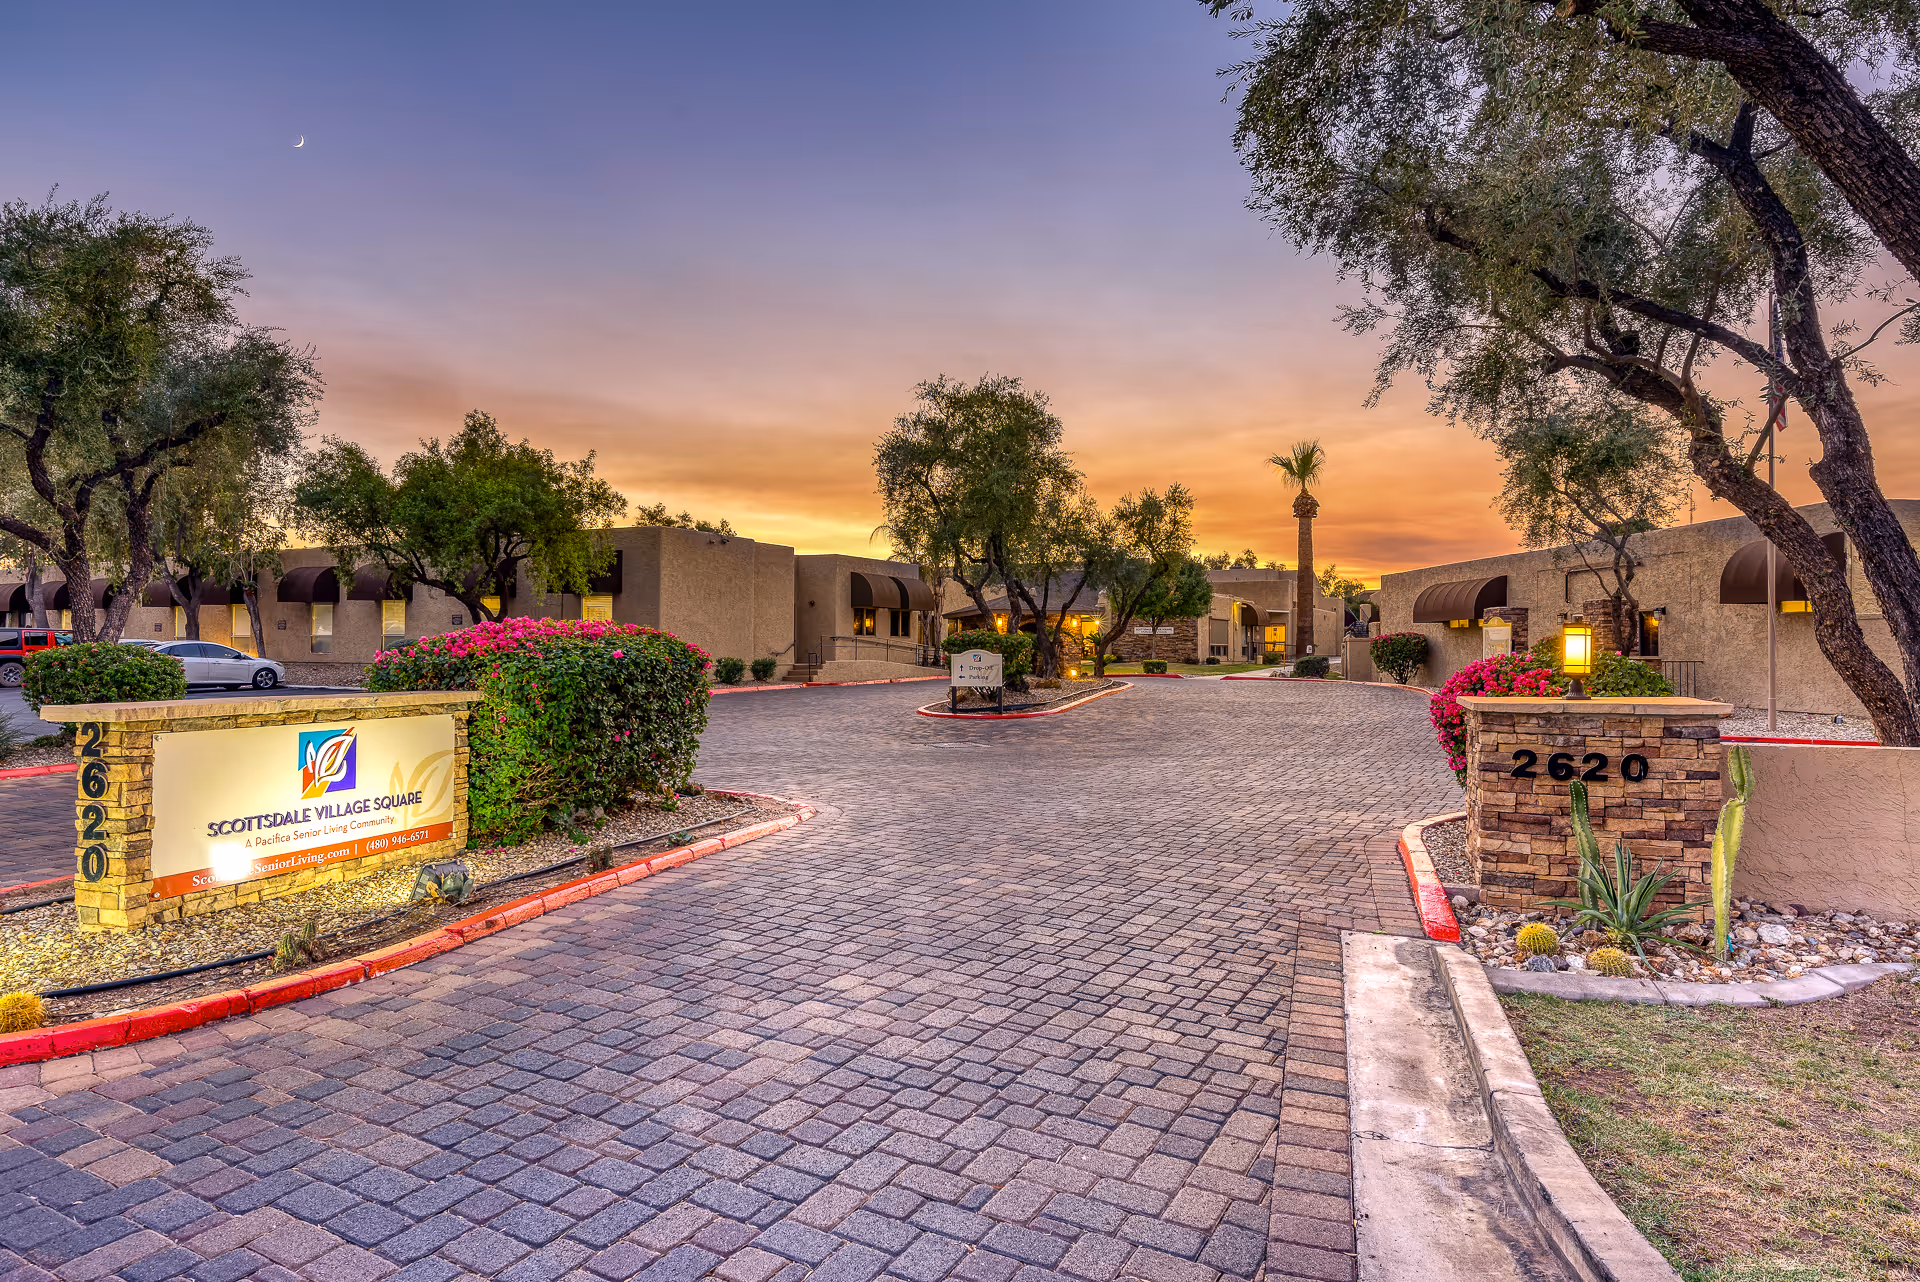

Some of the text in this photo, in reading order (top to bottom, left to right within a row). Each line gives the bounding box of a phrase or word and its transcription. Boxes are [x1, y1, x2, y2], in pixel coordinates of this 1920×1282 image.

[1510, 749, 1649, 783] 2620
[81, 722, 109, 883] 2620
[207, 791, 423, 838] SCOTTSDALE VILLAGE SQUARE
[245, 815, 395, 848] A Pacifica Senior Living Community
[192, 829, 429, 887] ScoeSeniorLiving.com (480) 946-6571
